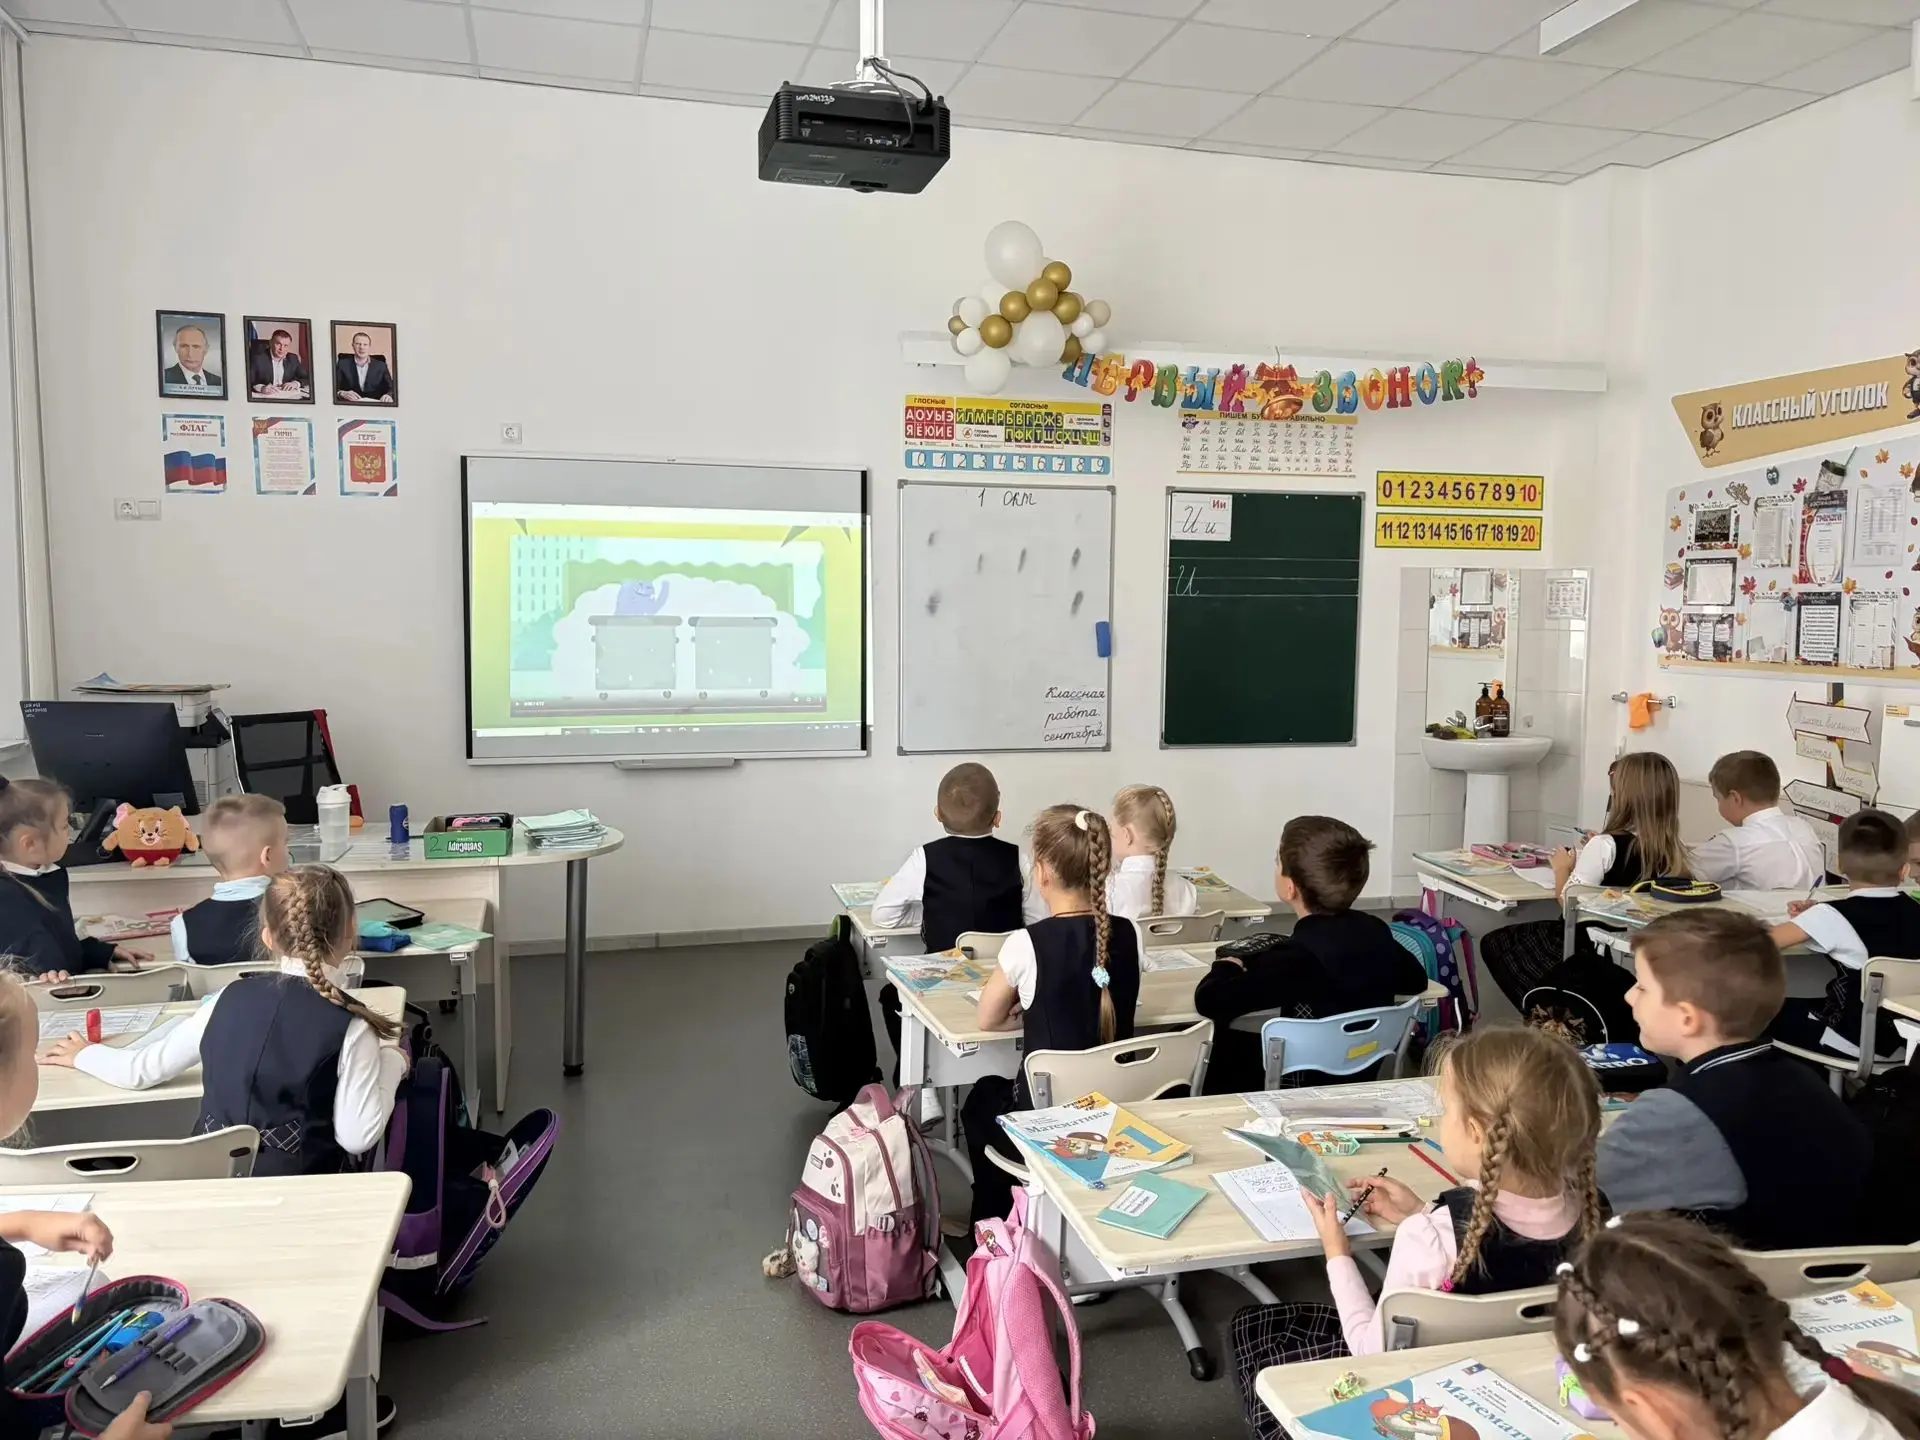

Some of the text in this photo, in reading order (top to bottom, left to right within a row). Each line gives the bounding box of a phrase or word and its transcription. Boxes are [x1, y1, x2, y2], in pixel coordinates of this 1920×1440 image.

[1312, 357, 1484, 414] ЗВОНОК!
[1732, 381, 1889, 429] КЛАССНЫЙ УГОЛОК
[1219, 411, 1248, 420] ПИШЕМ
[179, 424, 208, 432] ФЛАГ
[978, 487, 986, 507] 1
[1212, 499, 1227, 509] Ии
[1382, 521, 1536, 542] 11 12 13 14 15 16 17 18 19 20
[1045, 686, 1106, 699] Классная
[429, 836, 442, 852] 2
[447, 840, 483, 854] SvetoCopy
[1025, 1110, 1111, 1135] Математика
[1116, 1124, 1173, 1156] 1
